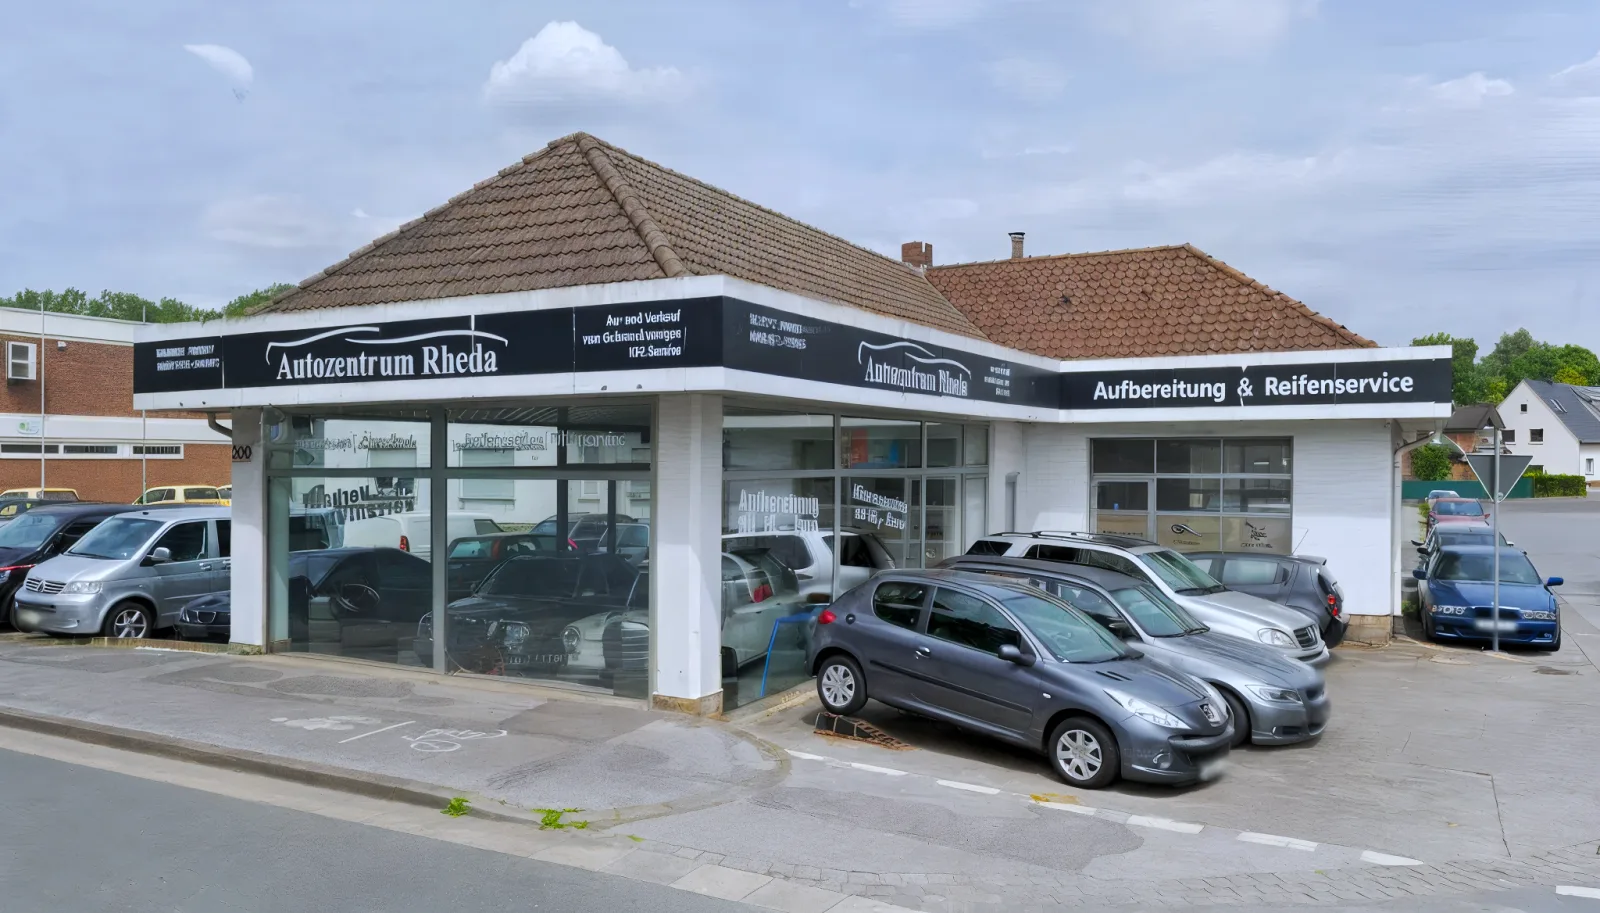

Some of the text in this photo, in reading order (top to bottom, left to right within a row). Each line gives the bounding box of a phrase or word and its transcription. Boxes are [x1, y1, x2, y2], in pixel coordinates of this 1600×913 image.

[276, 343, 498, 380] Autozentrum Rheda
[1093, 372, 1414, 402] Aufbereitung & Reifenservice
